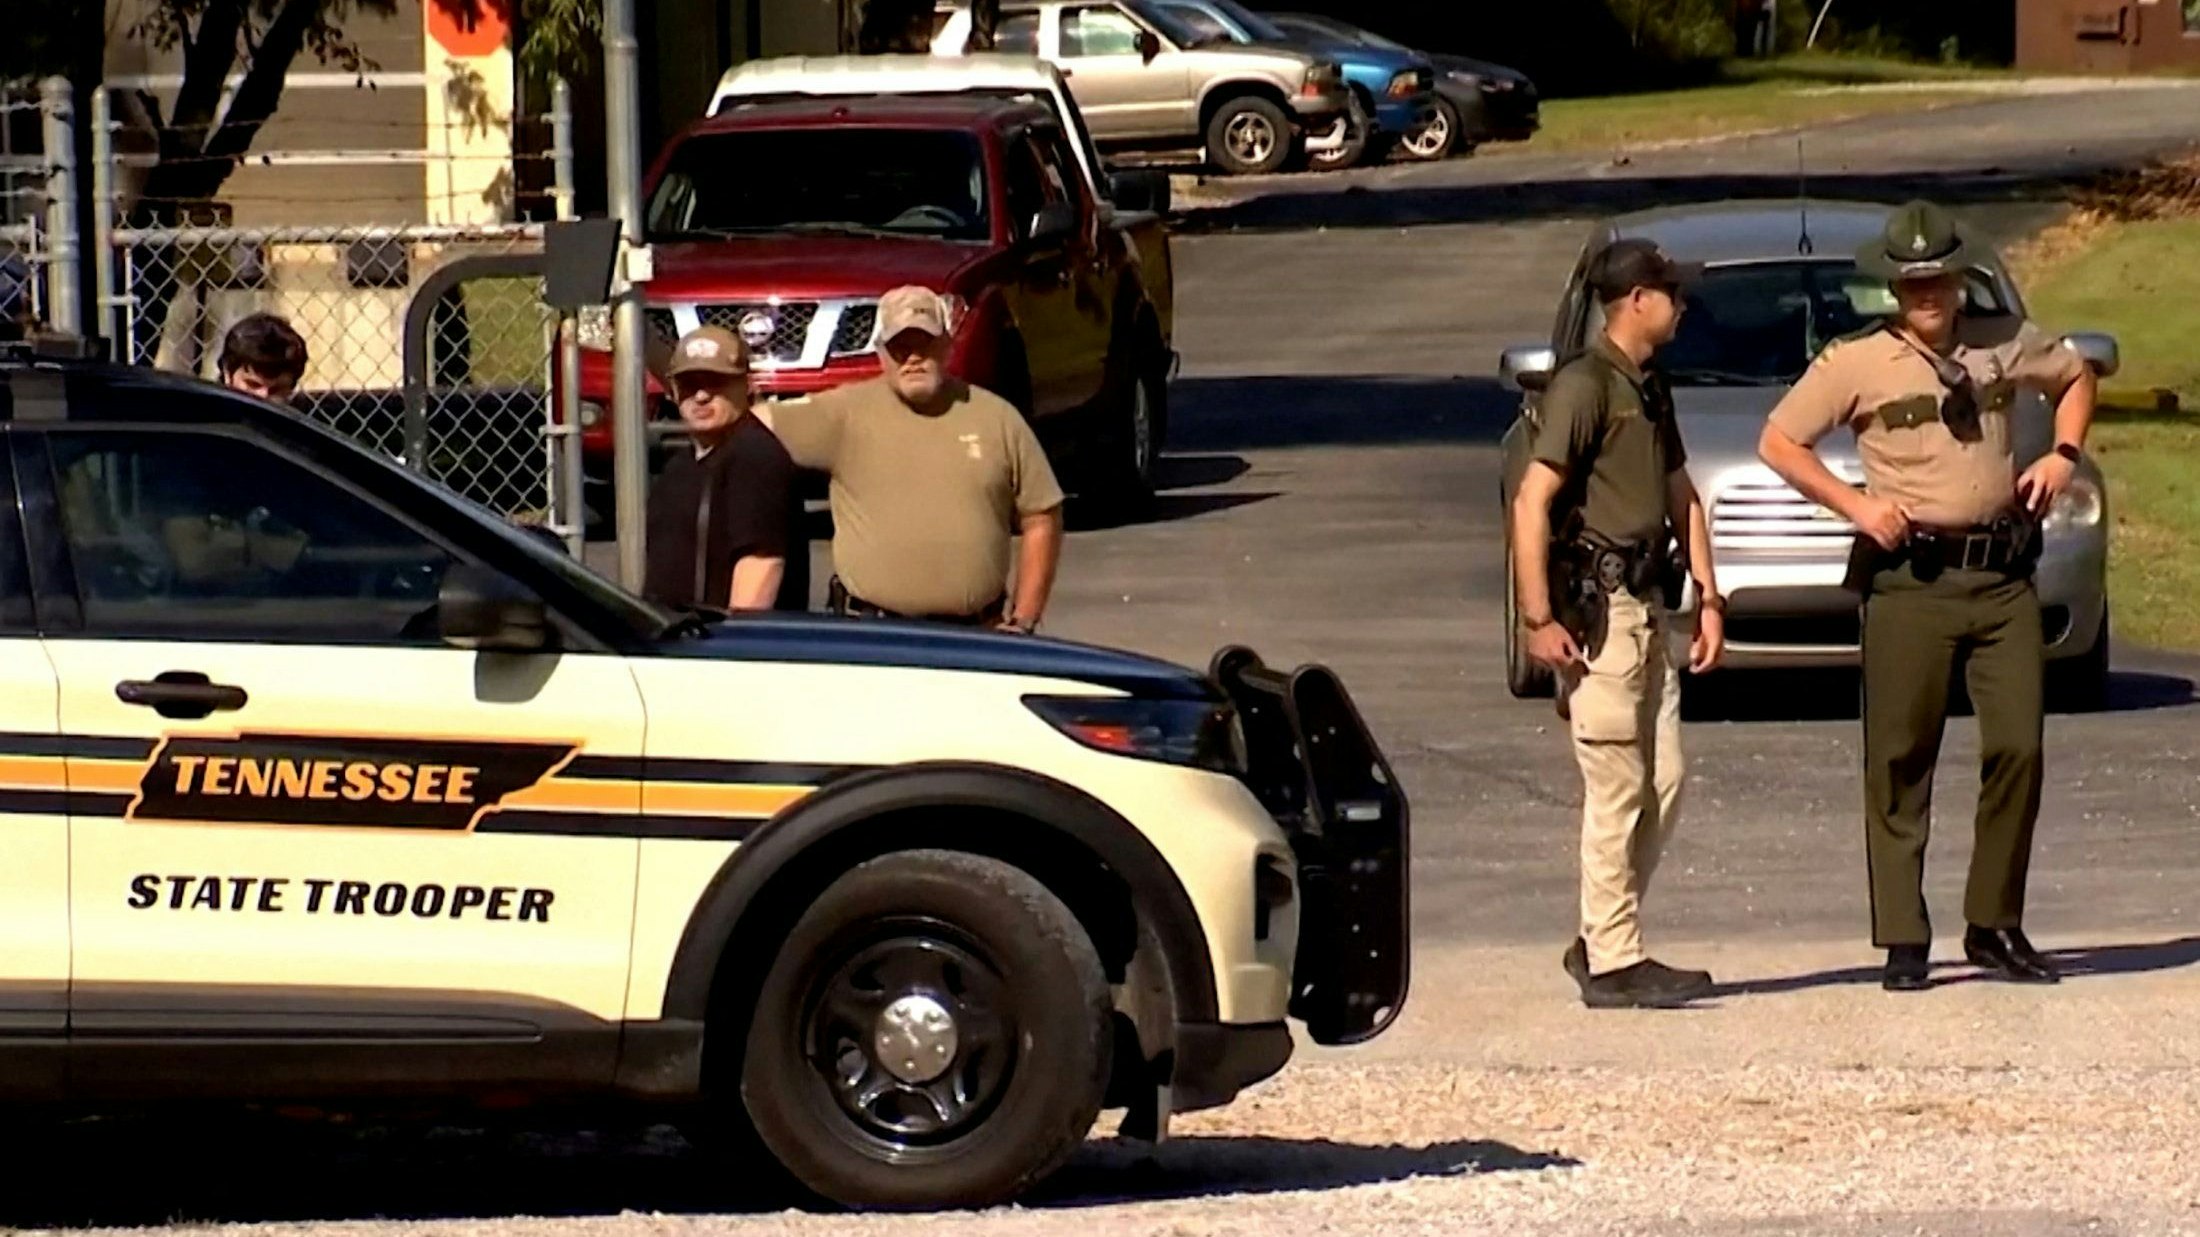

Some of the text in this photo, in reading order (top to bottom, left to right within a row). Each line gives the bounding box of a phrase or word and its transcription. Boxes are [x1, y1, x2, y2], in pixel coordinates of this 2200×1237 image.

[171, 755, 480, 803] TENNESSEE
[127, 874, 556, 923] STATE TROOPER
